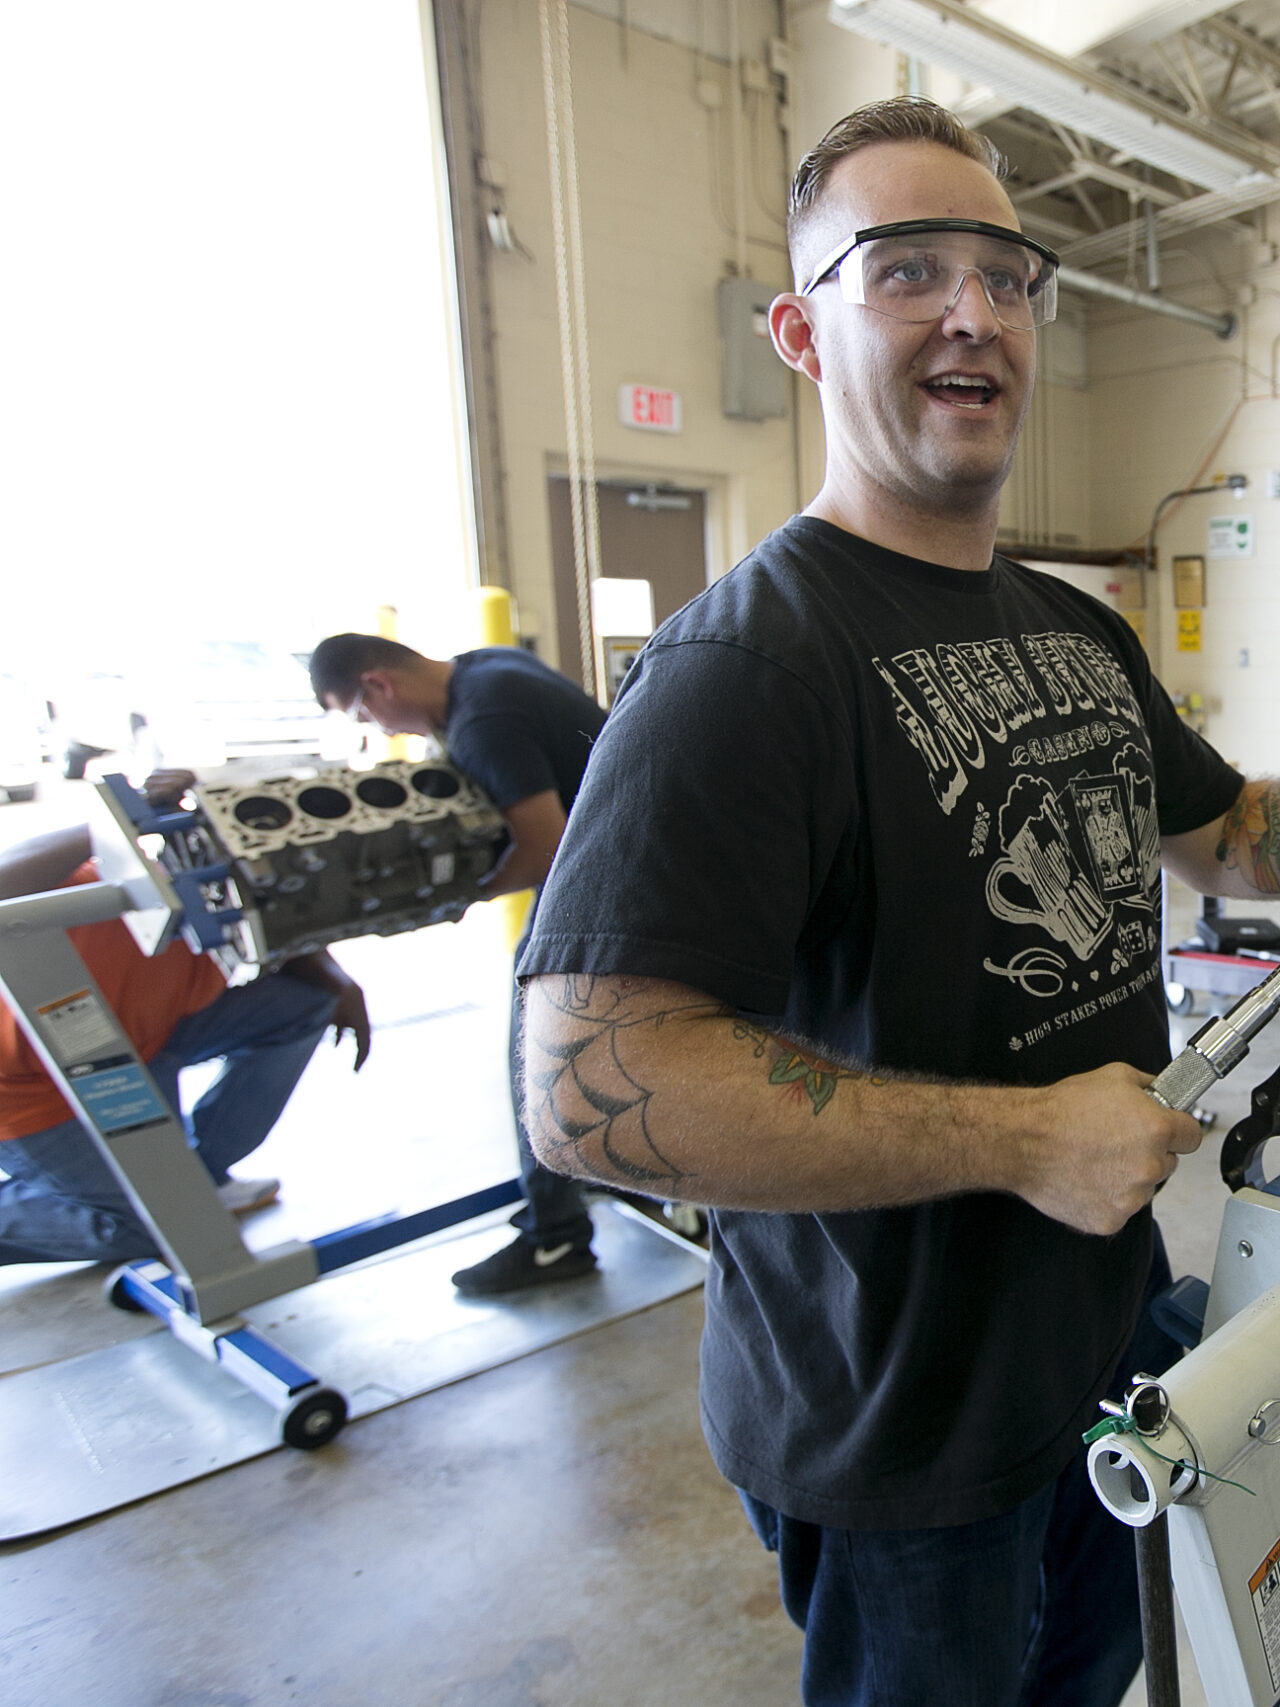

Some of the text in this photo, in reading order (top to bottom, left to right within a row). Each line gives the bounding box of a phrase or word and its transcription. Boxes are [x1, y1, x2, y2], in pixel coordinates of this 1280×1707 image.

[1027, 720, 1112, 766] CASINO
[1024, 1020, 1052, 1046] HIGH
[1054, 1000, 1098, 1030] STAKES
[1098, 985, 1130, 1011] POKER
